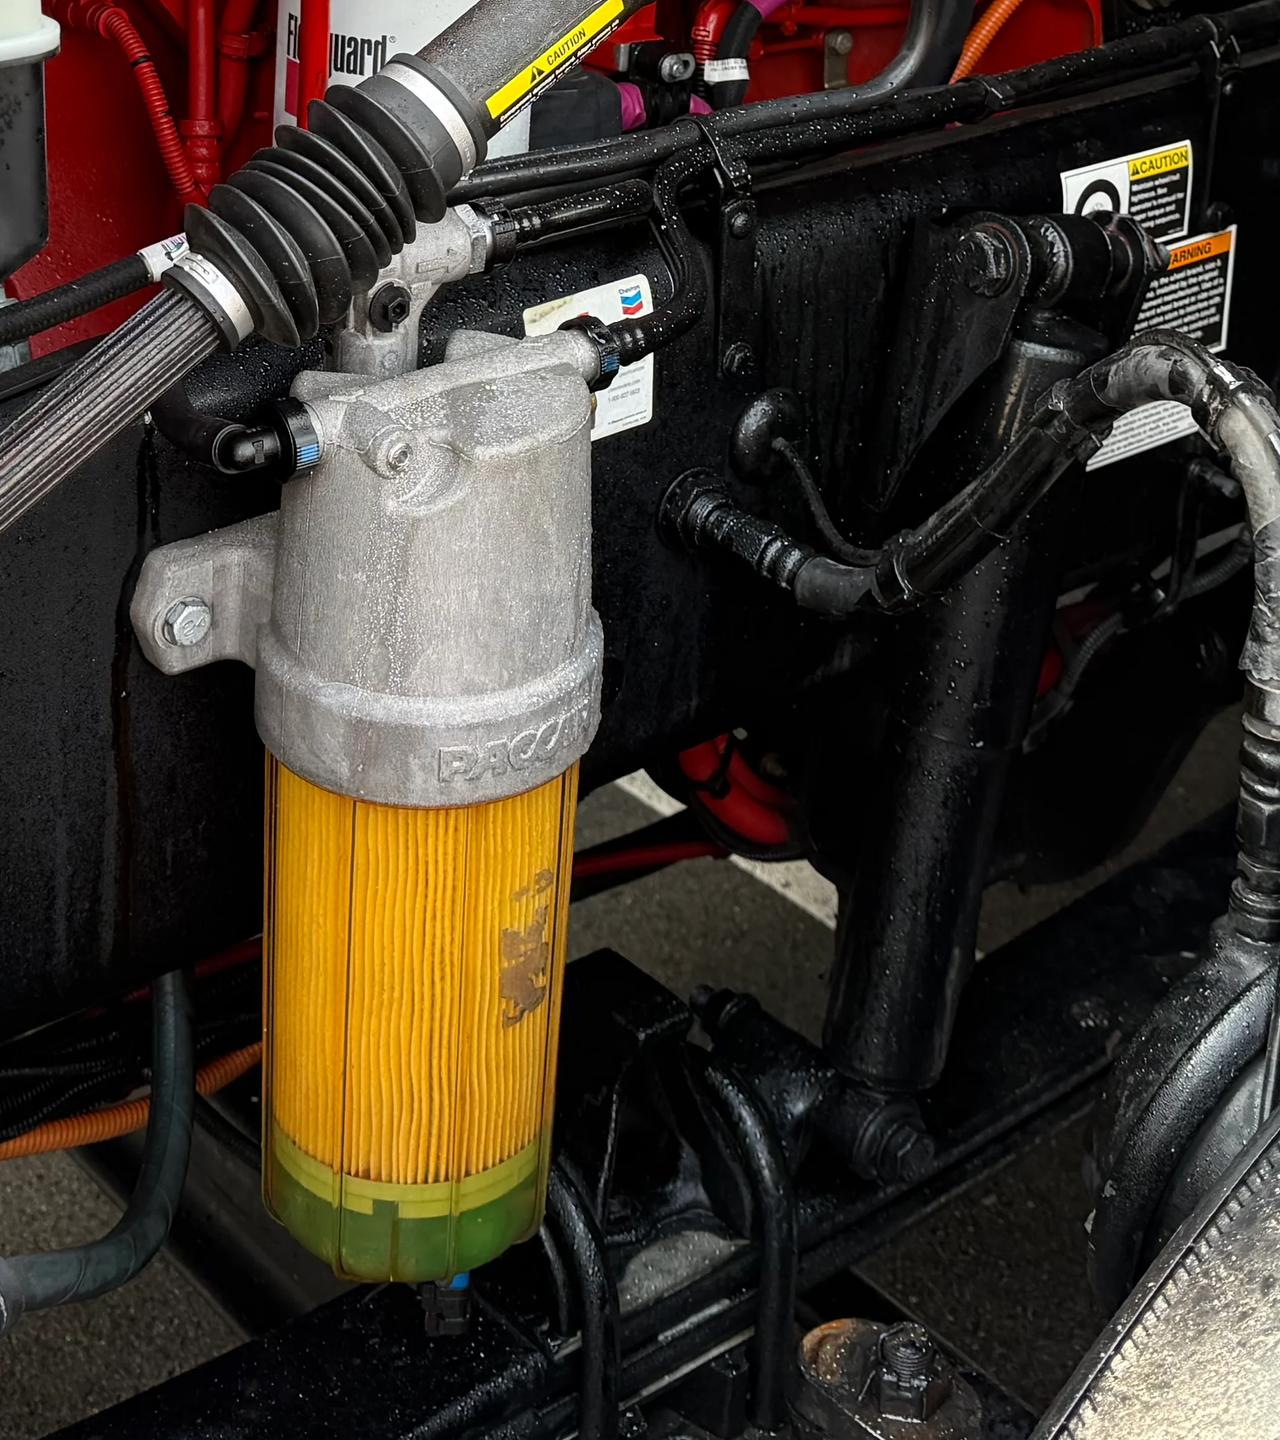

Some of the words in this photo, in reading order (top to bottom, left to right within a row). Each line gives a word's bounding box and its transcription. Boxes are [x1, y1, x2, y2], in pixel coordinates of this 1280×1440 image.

[546, 28, 587, 66] CAUTION
[1139, 149, 1190, 174] CAUTION
[1169, 241, 1212, 265] ARNING
